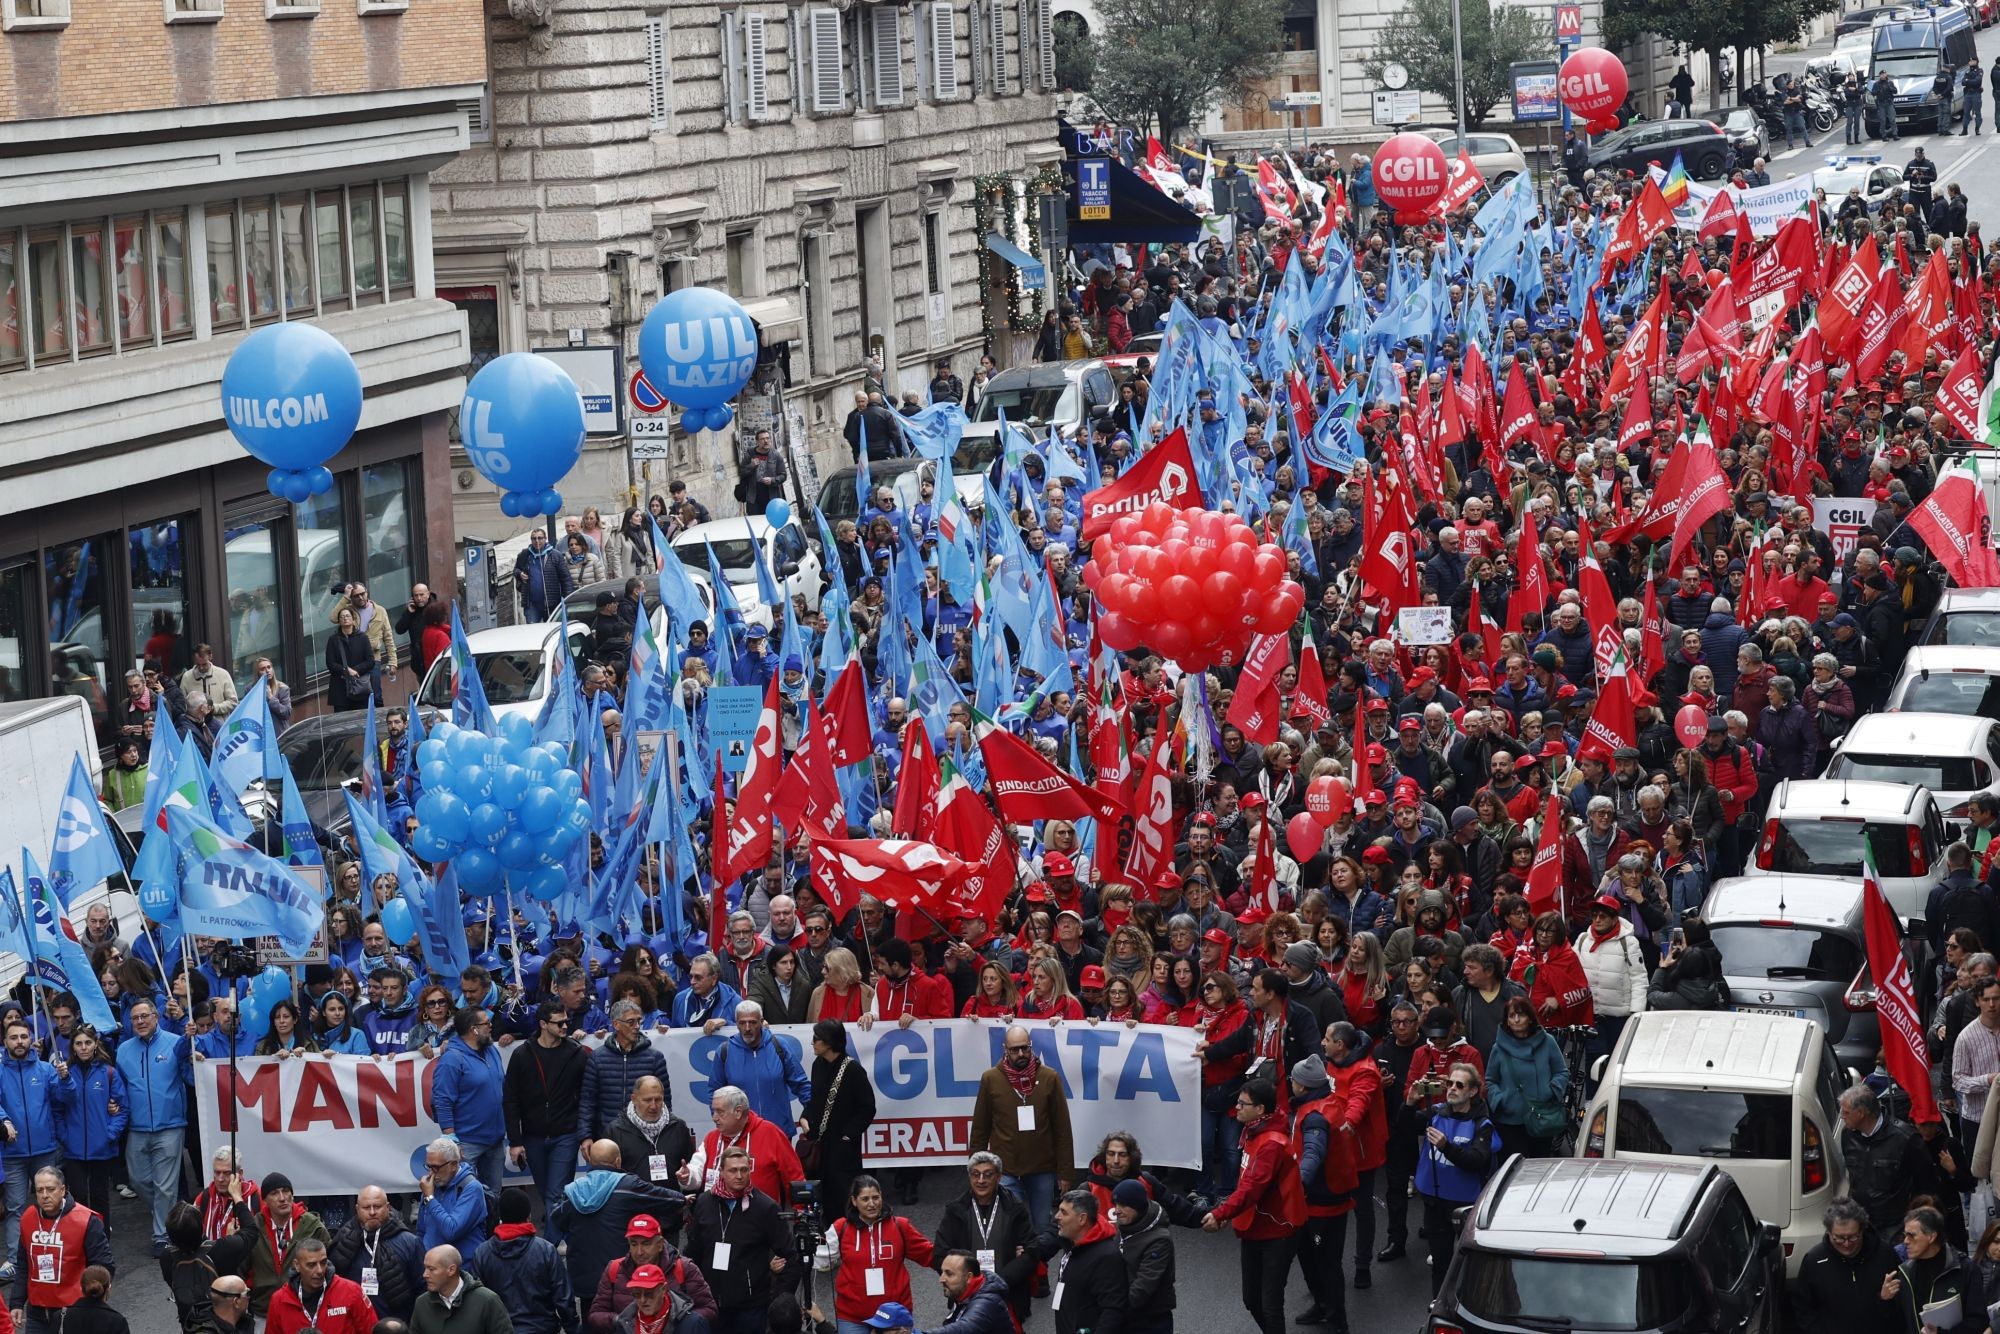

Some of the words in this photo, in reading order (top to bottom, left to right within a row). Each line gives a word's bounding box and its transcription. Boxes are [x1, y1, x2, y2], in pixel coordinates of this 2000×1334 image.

[1560, 11, 1579, 29] M
[1559, 72, 1609, 99] CGIL
[1075, 129, 1134, 154] BAR
[1379, 157, 1440, 183] CGIL
[1381, 186, 1405, 198] ROMA
[1407, 187, 1414, 197] E
[1415, 184, 1439, 197] LAZIO
[1083, 206, 1106, 215] LOTTO
[665, 316, 756, 364] UIL
[667, 357, 755, 388] LAZIO
[1957, 378, 1980, 407] SPI
[230, 393, 329, 428] UILCOM
[635, 422, 664, 432] 0-24
[1829, 509, 1866, 523] CGIL
[468, 549, 477, 563] P
[1308, 794, 1330, 804] CGIL
[1308, 804, 1330, 812] LAZIO
[144, 887, 170, 904] UIL
[203, 861, 314, 916] ITALUIL
[216, 1060, 439, 1133] MAN
